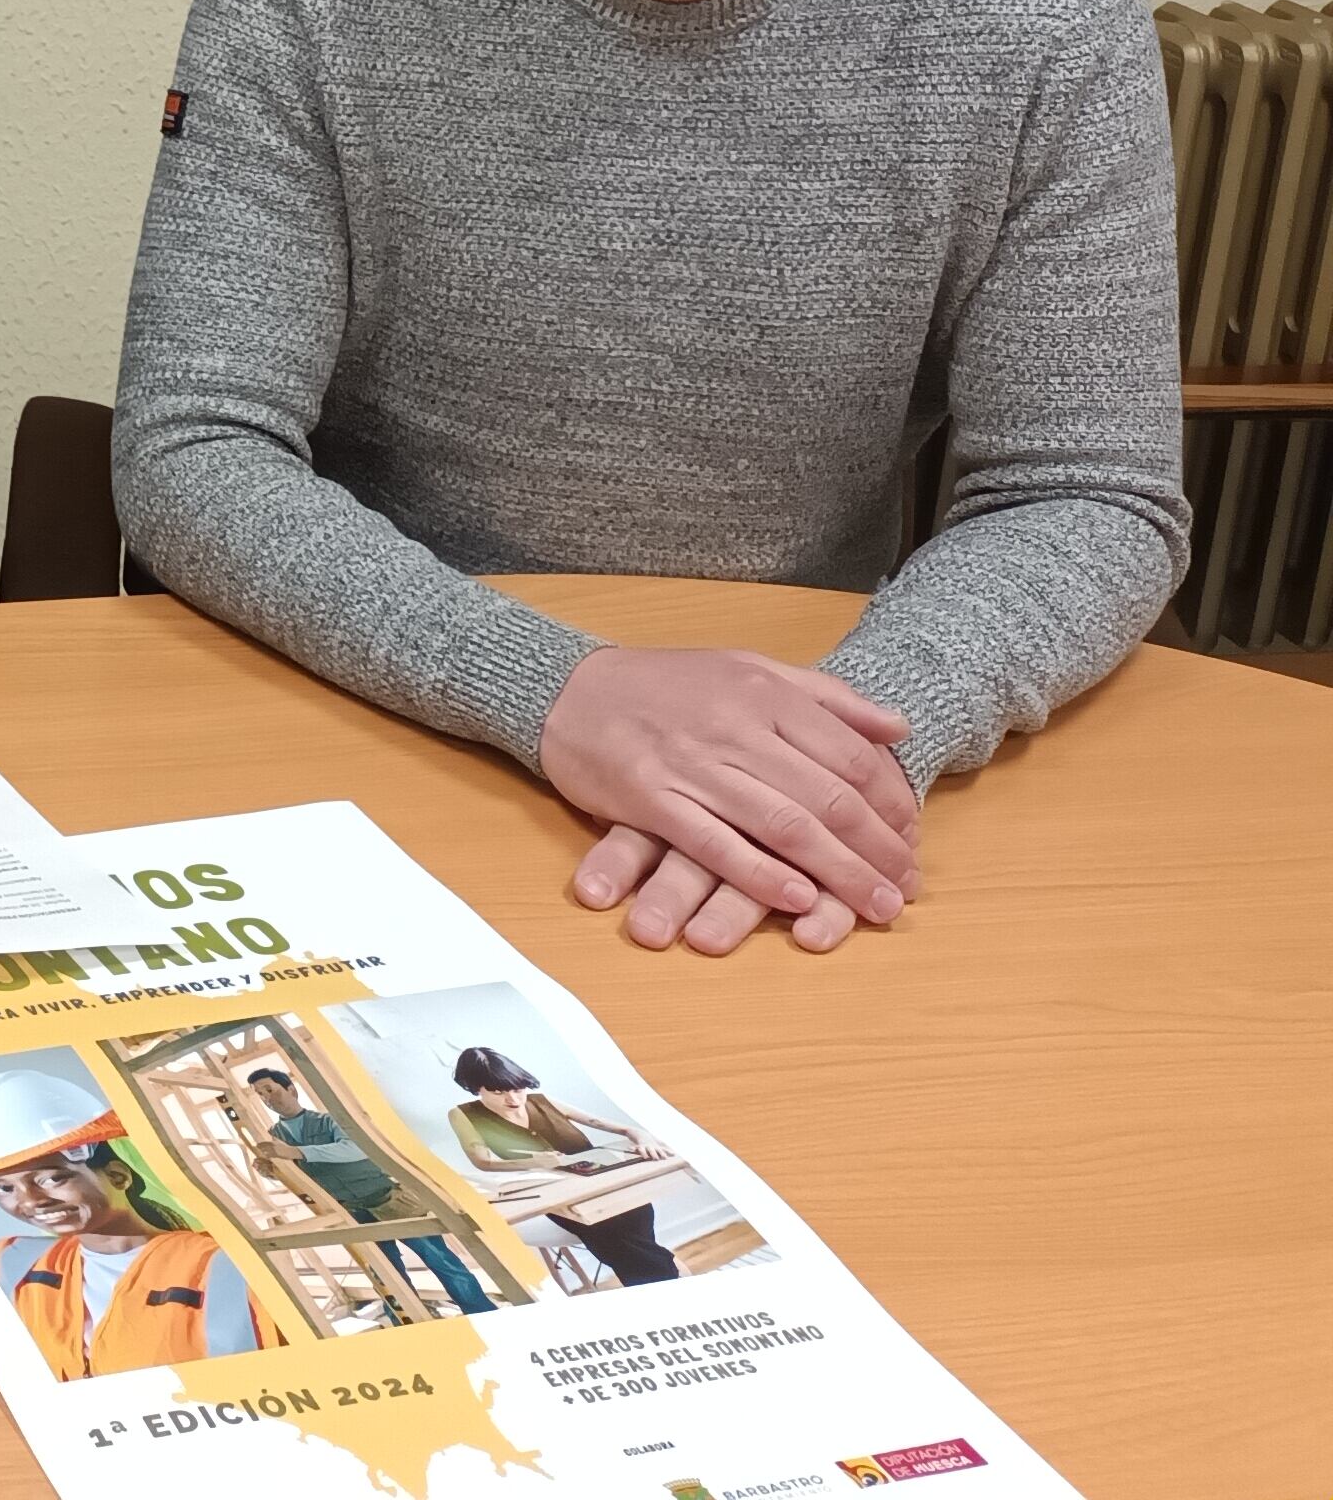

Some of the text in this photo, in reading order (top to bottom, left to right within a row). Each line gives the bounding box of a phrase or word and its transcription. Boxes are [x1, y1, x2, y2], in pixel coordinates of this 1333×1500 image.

[100, 976, 235, 1006] EMPRENDER
[240, 973, 253, 985] Y
[259, 955, 387, 982] DISFRUTAR
[530, 1311, 776, 1367] 4 CENTROS FORMATIVOS
[542, 1324, 825, 1388] EMPRESAS DEL SOMONTANO
[577, 1384, 612, 1404] DE
[611, 1375, 659, 1398] 300
[665, 1358, 758, 1389] JOVENES
[88, 1373, 435, 1448] 1ª EDICIÓN 2024
[622, 1440, 676, 1457] COLABORA
[879, 1443, 962, 1468] DIPUTACIÓN
[891, 1454, 974, 1479] DE HUESCA
[721, 1474, 825, 1500] BARBASTRO
